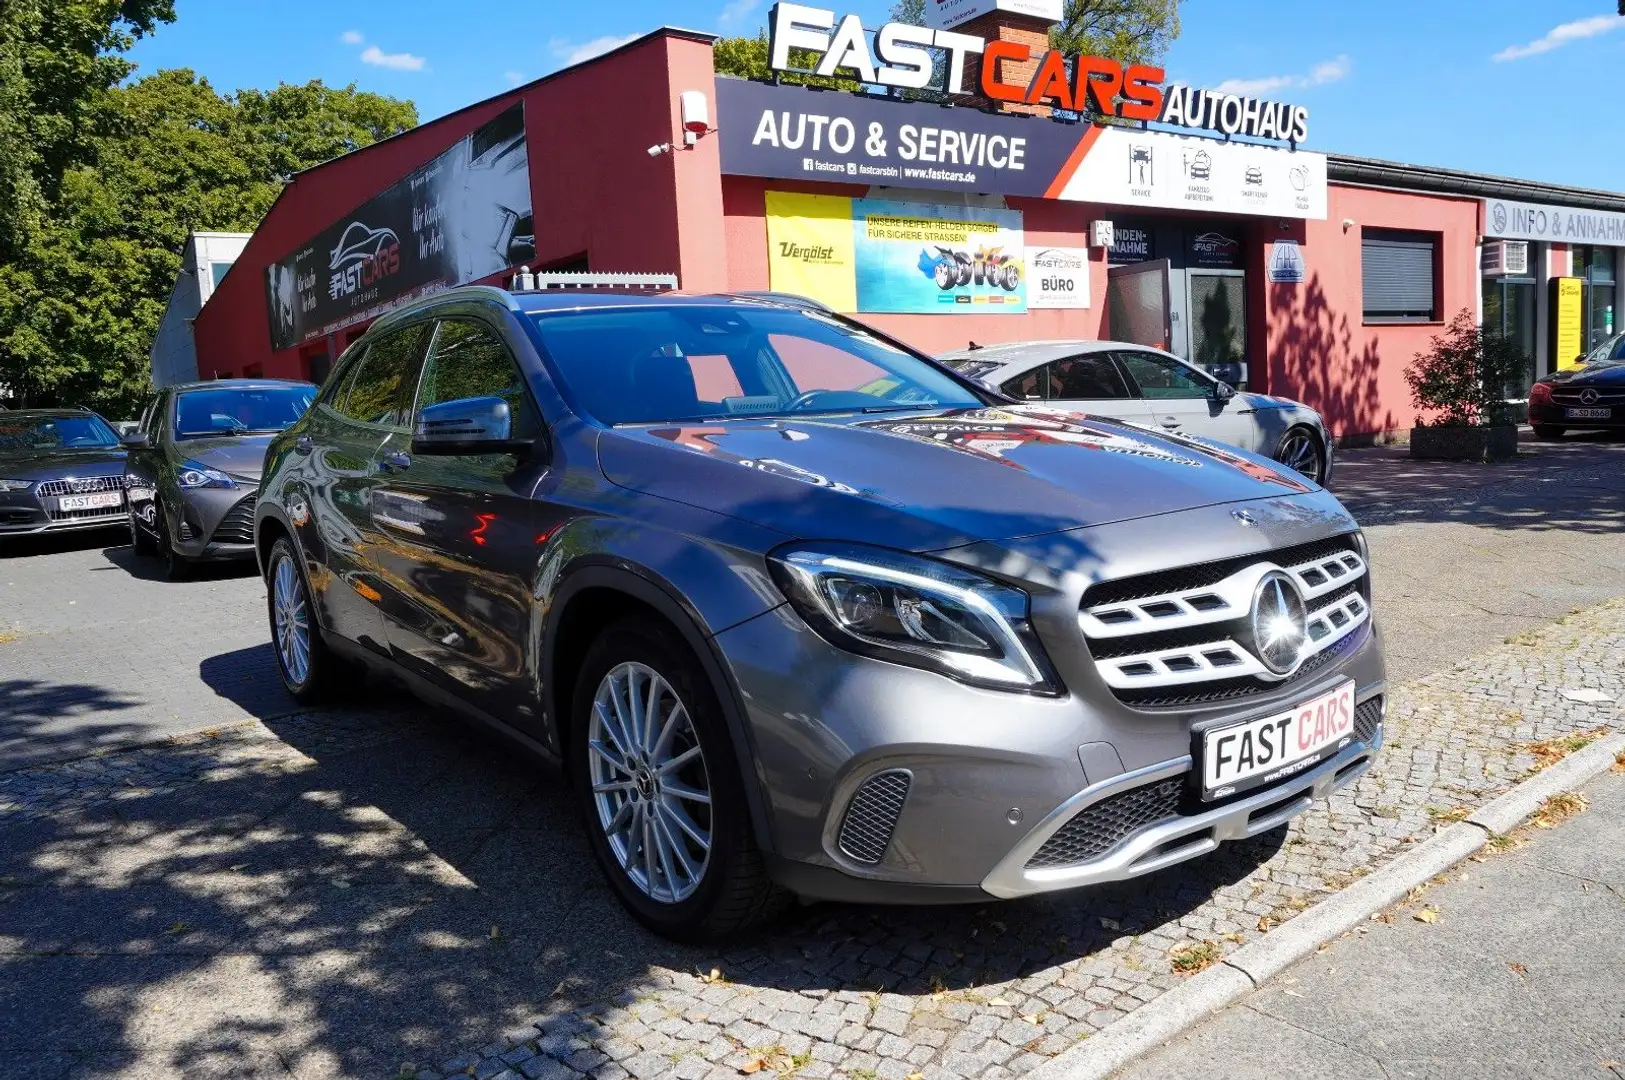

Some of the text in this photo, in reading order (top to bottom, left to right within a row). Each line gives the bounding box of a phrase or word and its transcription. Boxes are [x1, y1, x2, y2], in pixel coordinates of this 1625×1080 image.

[1162, 84, 1309, 143] AUTOHAUS
[752, 109, 1026, 171] AUTO & SERVICE
[815, 161, 845, 172] fastcars
[904, 167, 976, 183] www.fastcars.de
[1131, 188, 1151, 198] SERVICE
[867, 216, 901, 228] UNSERE
[966, 223, 998, 233] SORGEN
[1512, 207, 1548, 235] INFO
[1551, 211, 1562, 237] &
[868, 228, 885, 238] FÜR
[886, 230, 922, 240] SICHERE
[779, 241, 834, 263] Vergölst
[1041, 275, 1075, 292] BÜRO
